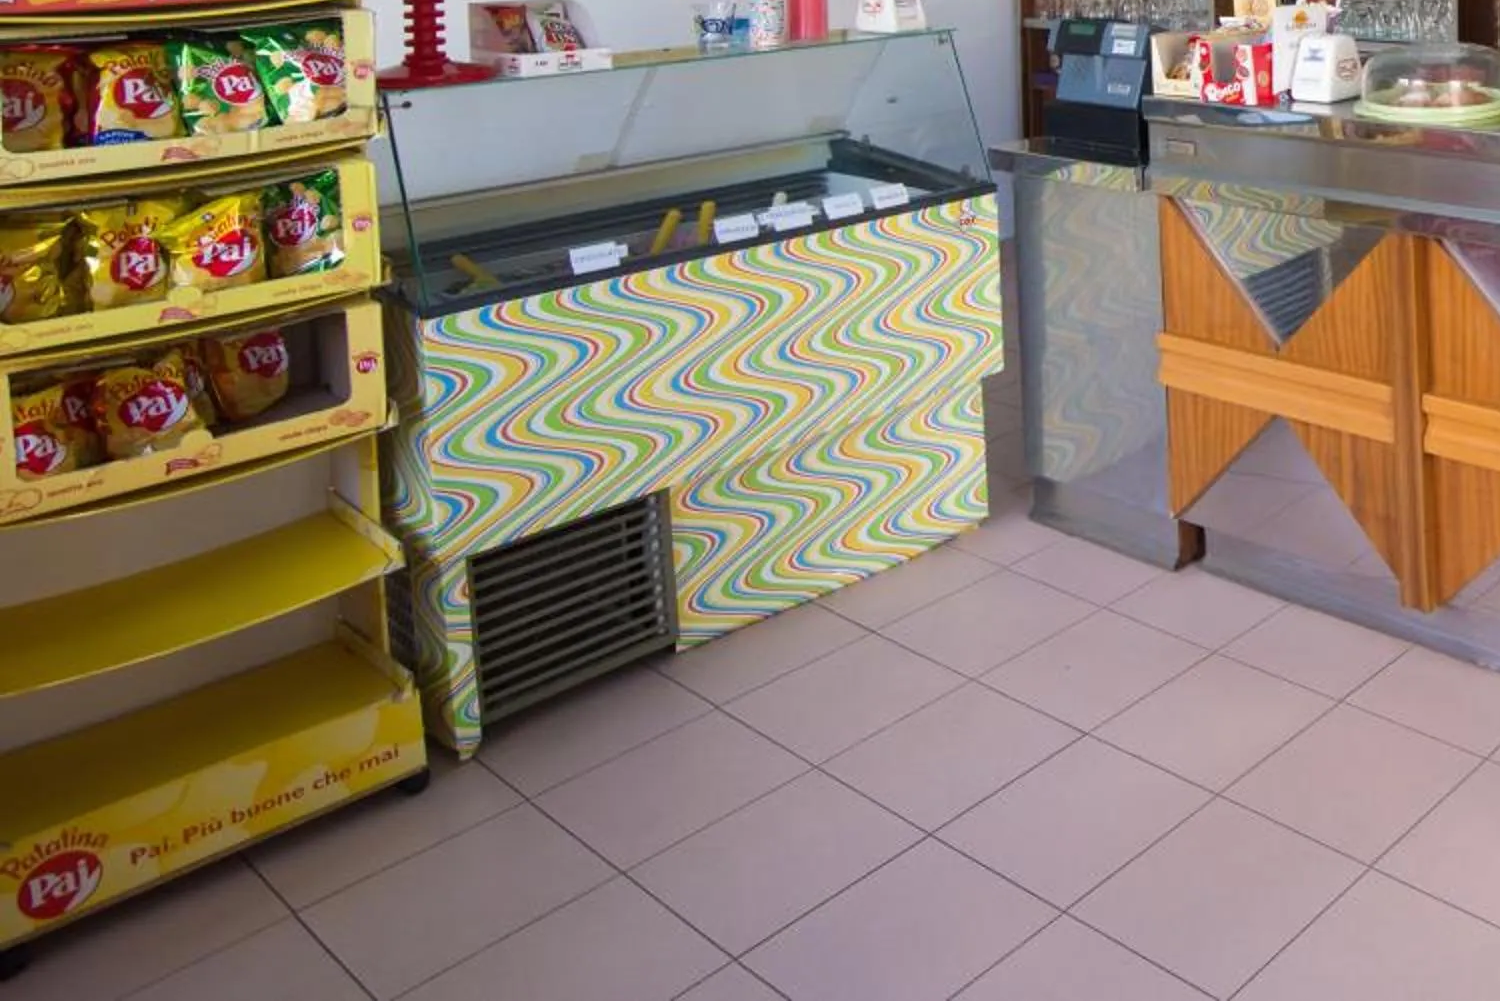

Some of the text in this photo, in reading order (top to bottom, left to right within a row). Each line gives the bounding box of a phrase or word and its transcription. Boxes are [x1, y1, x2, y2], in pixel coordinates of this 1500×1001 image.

[1, 90, 43, 125] ai
[130, 743, 401, 866] Pai. Più buone che mai
[1, 825, 109, 880] Patatina
[27, 859, 101, 912] Pai
